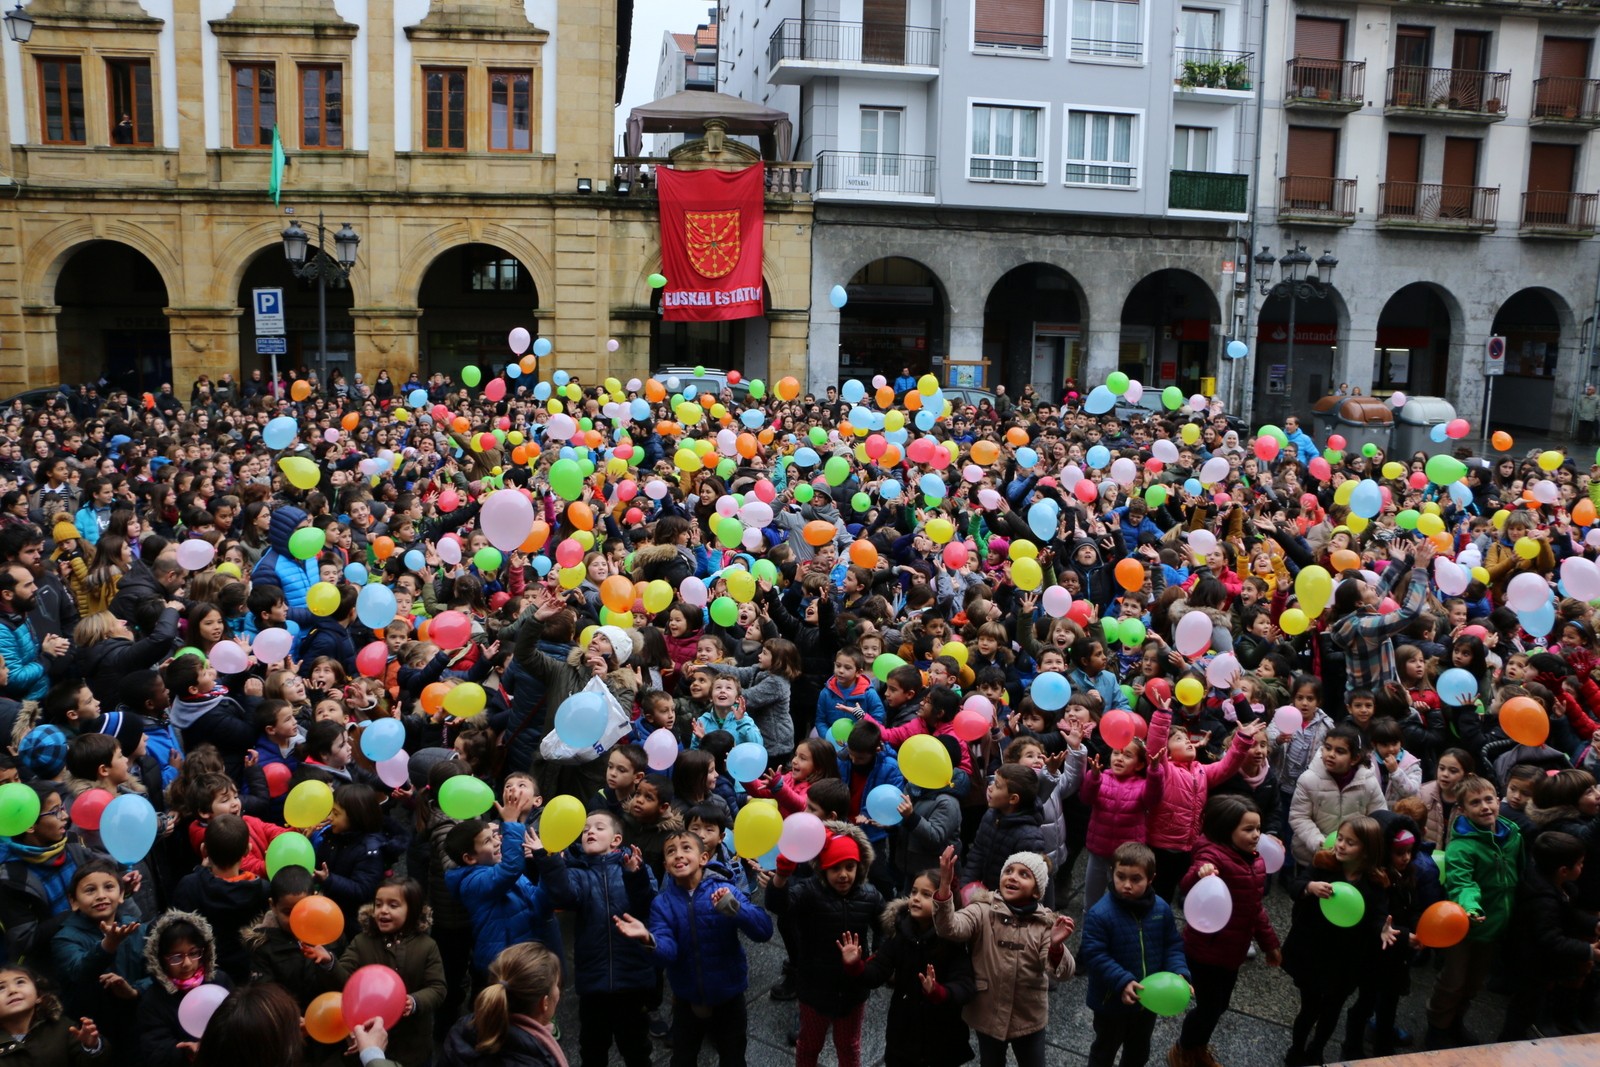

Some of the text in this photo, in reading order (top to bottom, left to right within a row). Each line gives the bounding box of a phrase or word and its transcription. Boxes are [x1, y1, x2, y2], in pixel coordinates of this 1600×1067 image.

[261, 294, 275, 312] P
[665, 291, 712, 306] EUSKAL
[1291, 328, 1338, 341] antand
